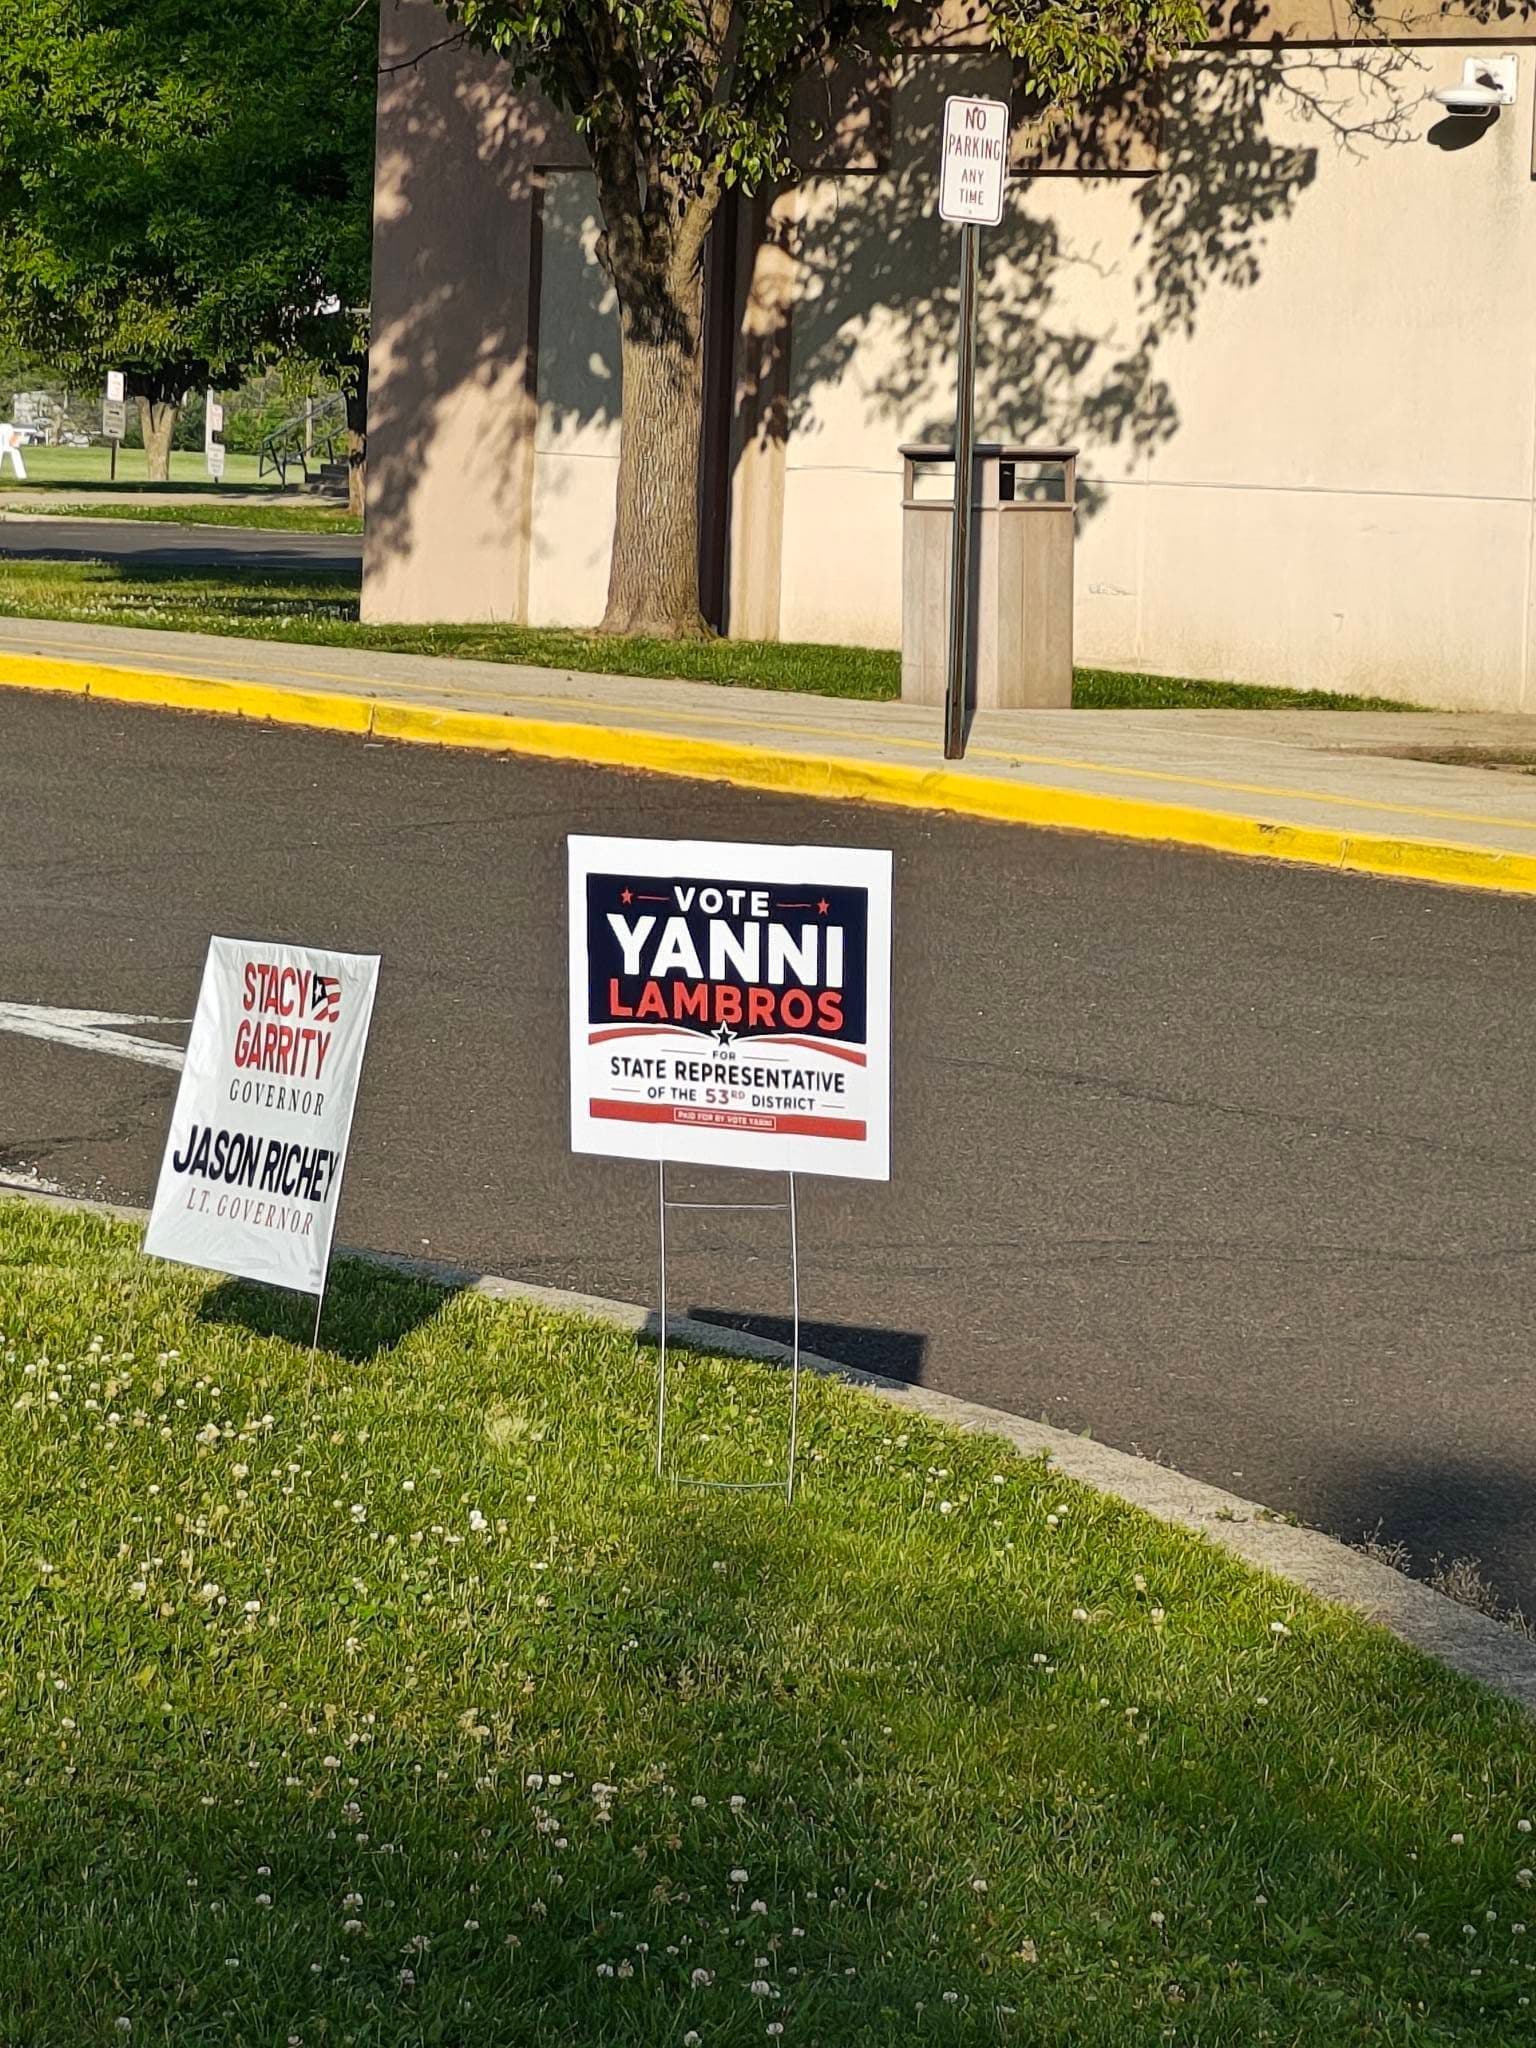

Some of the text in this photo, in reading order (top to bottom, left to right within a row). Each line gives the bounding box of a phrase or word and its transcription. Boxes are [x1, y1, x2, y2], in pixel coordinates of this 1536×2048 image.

[965, 106, 987, 131] NO
[948, 133, 1001, 161] PARKING
[961, 168, 985, 185] ANY
[960, 187, 985, 206] TIME
[674, 886, 769, 917] VOTE
[607, 913, 843, 988] YANNI
[243, 962, 312, 1018] STACY
[609, 978, 843, 1031] LAMBROS
[234, 1019, 331, 1080] GARRITY
[712, 1051, 736, 1061] FOR
[611, 1056, 845, 1093] STATE REPRESENTATIVE
[229, 1078, 325, 1117] GOVERNOR
[647, 1087, 665, 1099] OF
[671, 1088, 697, 1101] THE
[752, 1095, 816, 1111] DISTRICT
[678, 1110, 696, 1119] PAID
[173, 1125, 341, 1204] JASON RICHEY
[186, 1187, 314, 1236] LT. GOVERNOR
